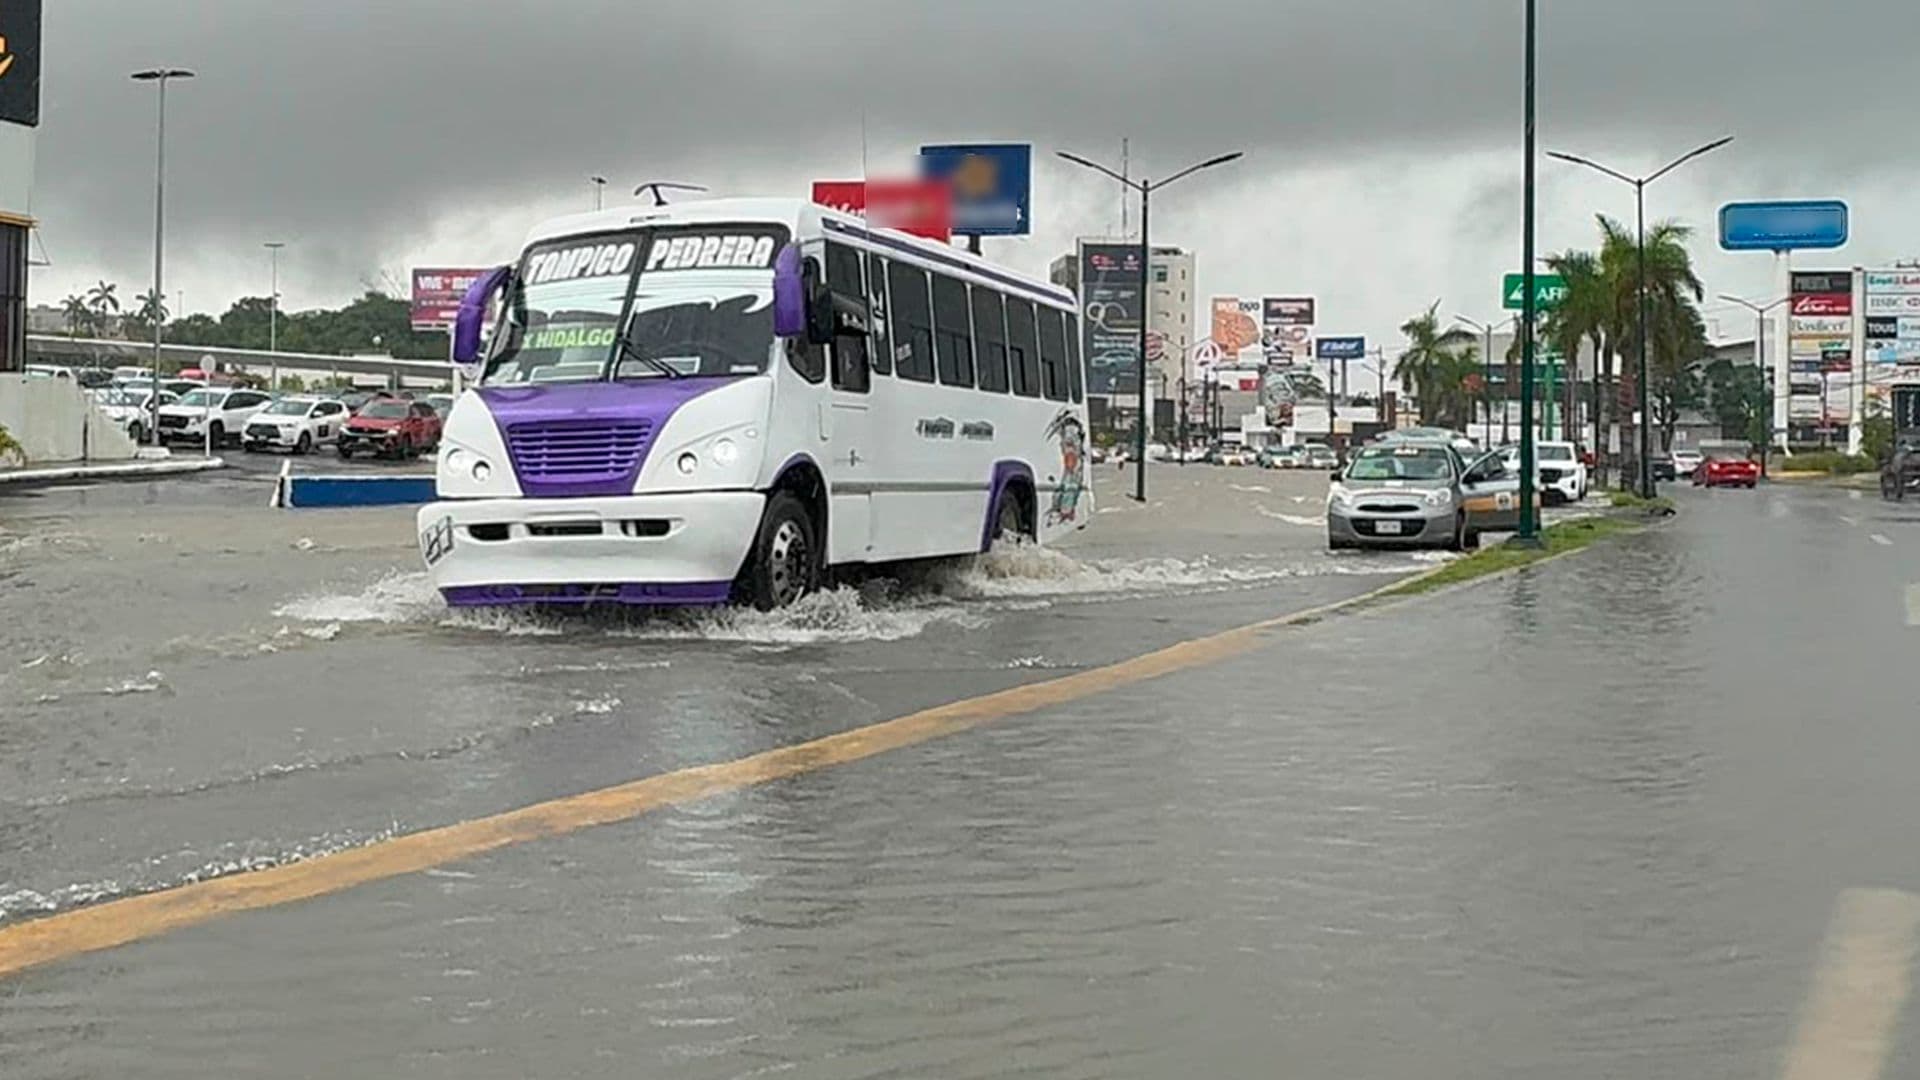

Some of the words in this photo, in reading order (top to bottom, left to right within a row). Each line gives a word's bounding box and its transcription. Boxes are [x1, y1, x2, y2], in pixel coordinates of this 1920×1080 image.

[526, 243, 635, 284] TAMPICO
[645, 236, 775, 269] PEDRERA
[536, 327, 616, 348] HIDALGO
[1867, 323, 1896, 333] TOUS
